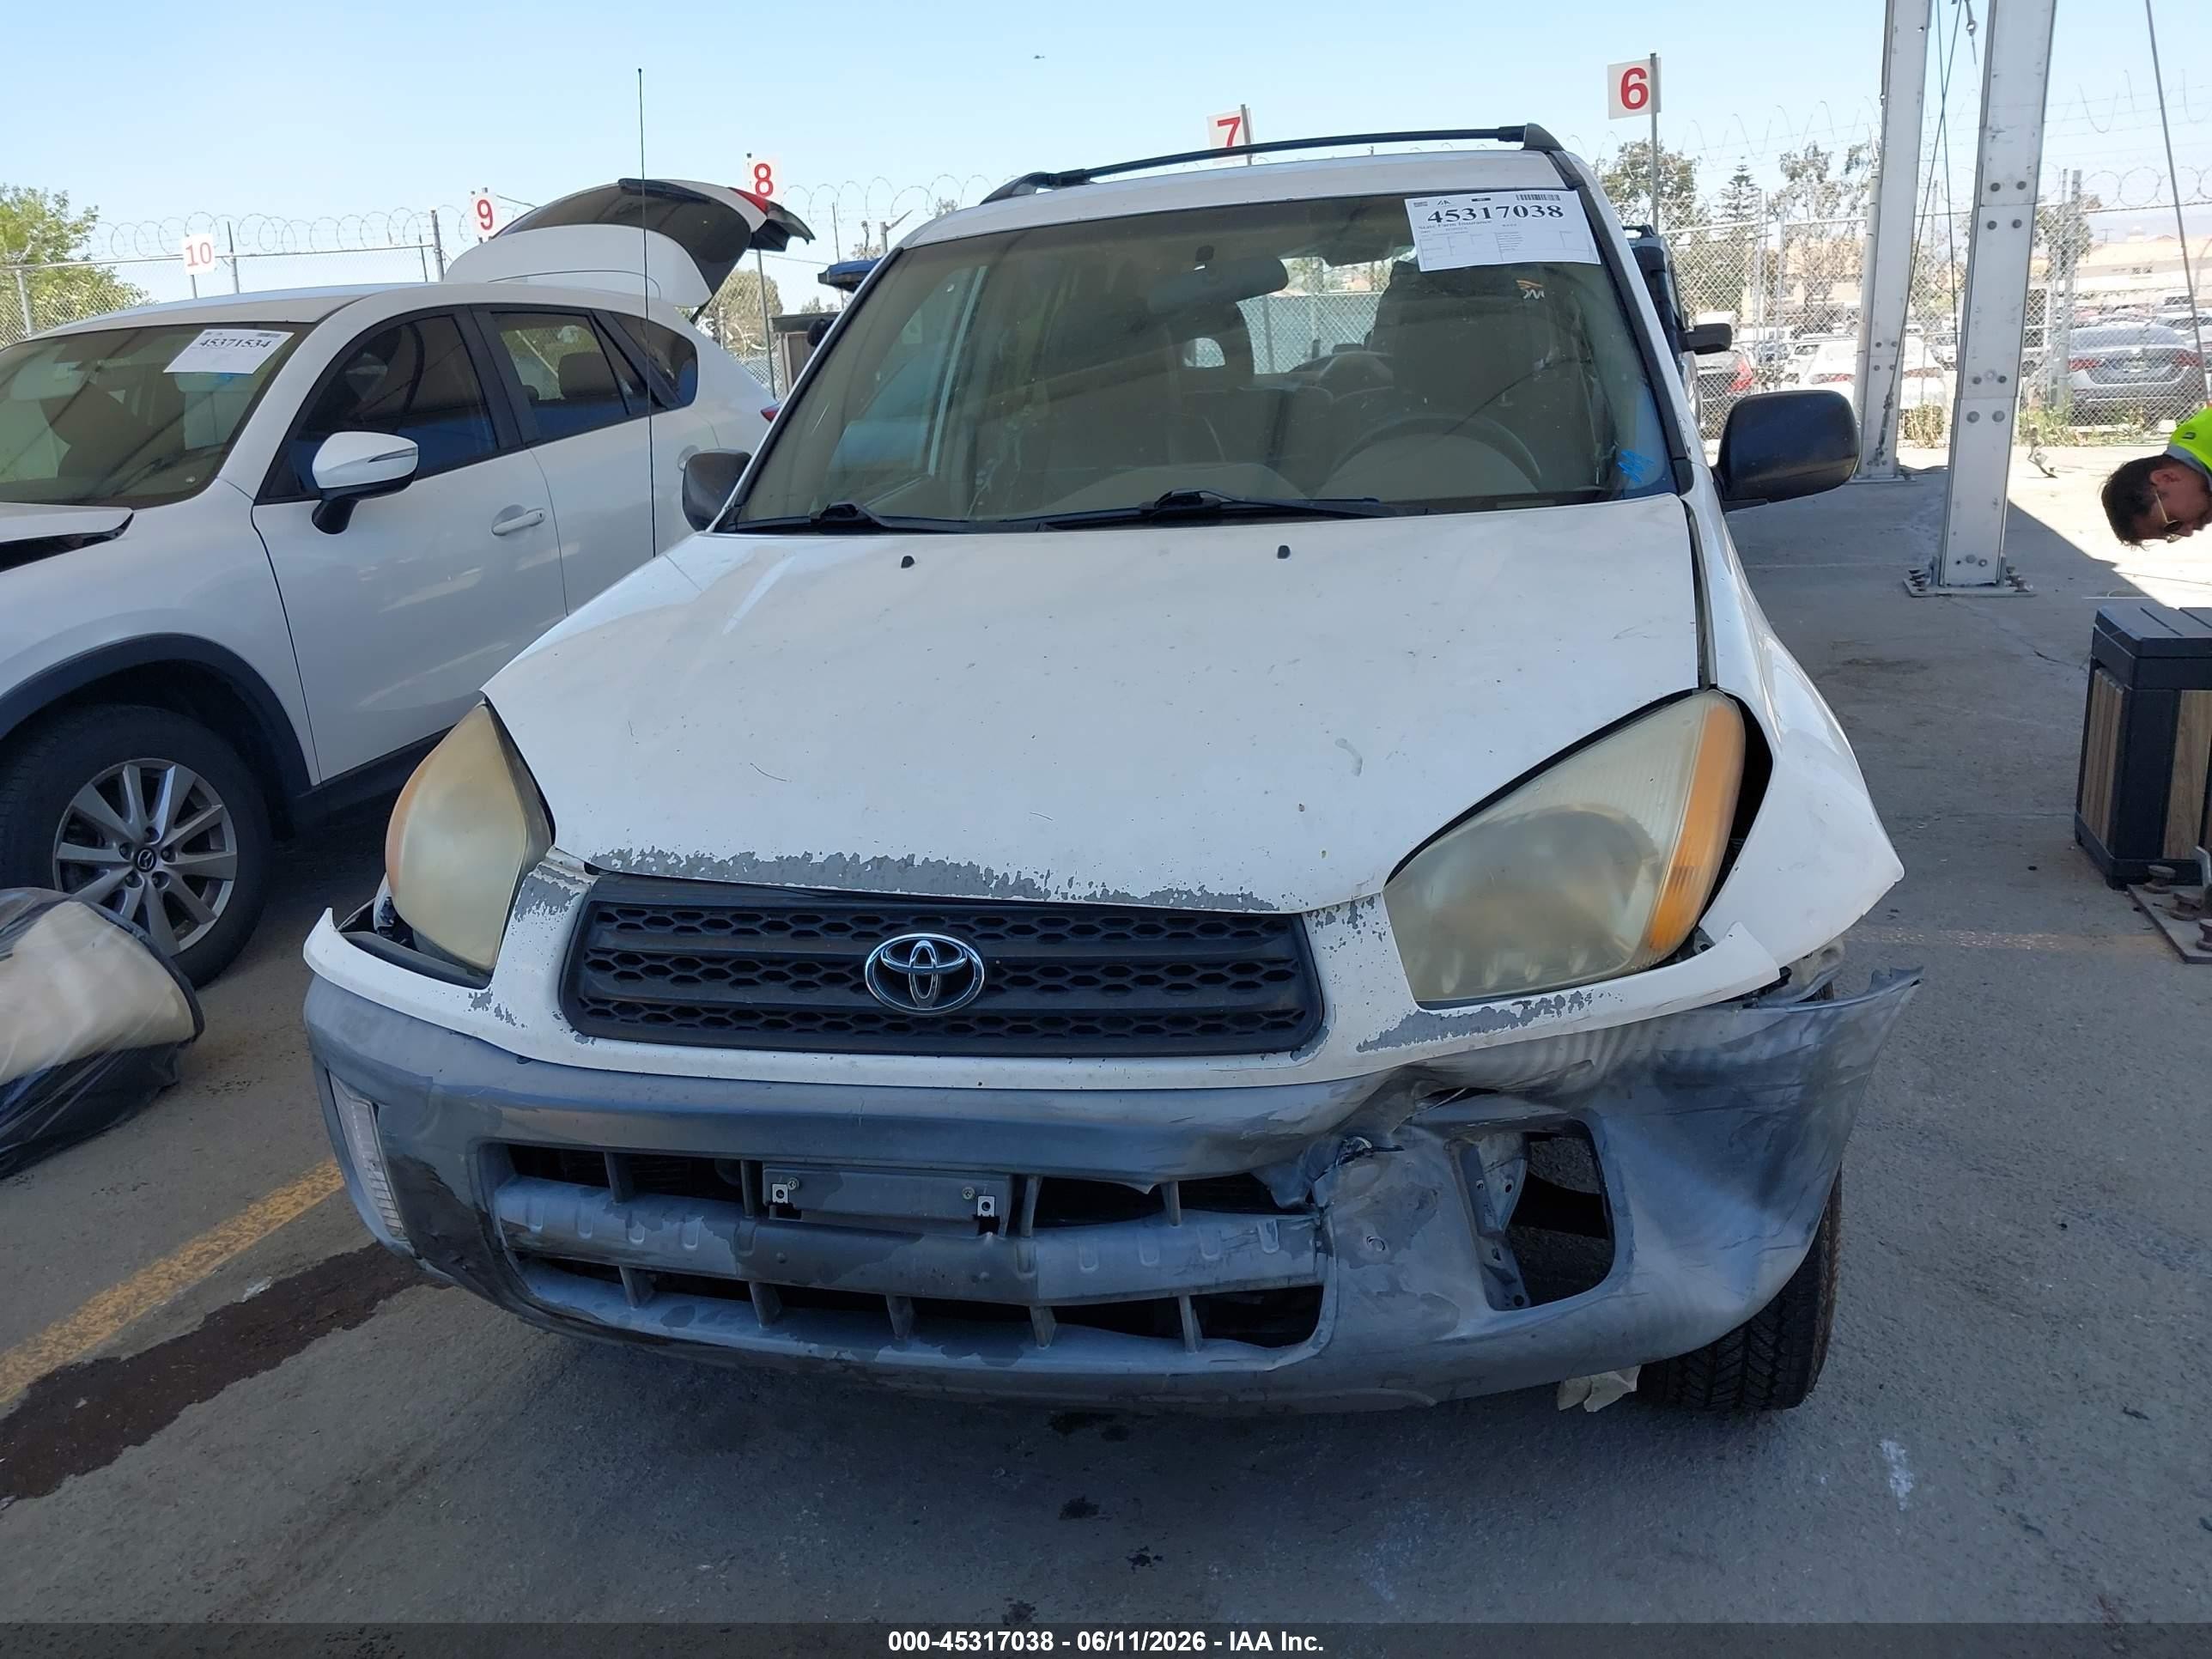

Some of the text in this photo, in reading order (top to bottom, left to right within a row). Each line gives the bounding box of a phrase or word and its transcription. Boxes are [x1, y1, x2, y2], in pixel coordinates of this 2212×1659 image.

[1620, 67, 1649, 110] 6
[1217, 116, 1240, 148] 7
[754, 163, 774, 198] 8
[477, 199, 494, 231] 9
[1427, 204, 1565, 223] 45317038
[185, 241, 212, 267] 10
[199, 338, 271, 348] 45371534
